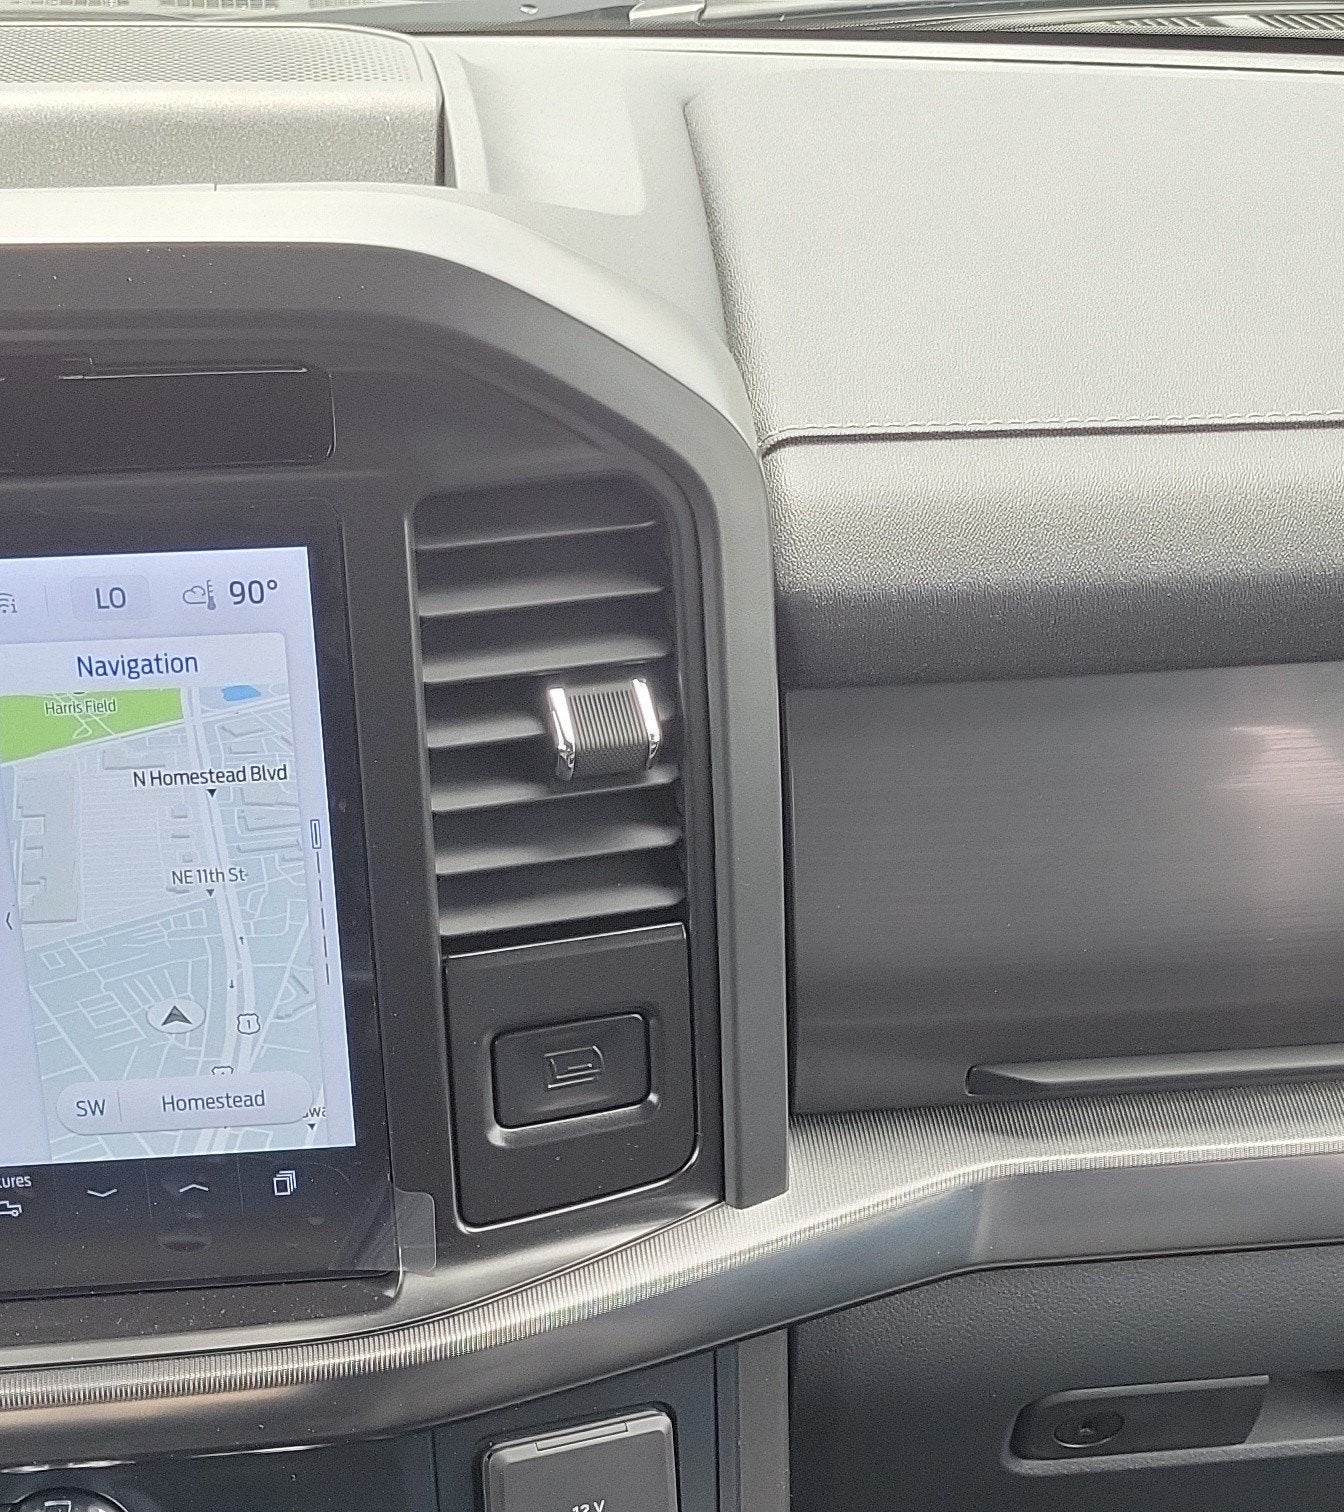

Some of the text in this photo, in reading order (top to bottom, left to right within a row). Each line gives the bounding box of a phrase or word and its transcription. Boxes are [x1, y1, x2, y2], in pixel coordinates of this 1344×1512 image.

[95, 586, 127, 610] LO
[228, 579, 278, 606] 90°
[76, 651, 200, 680] Navigation
[44, 698, 117, 716] Harris Field
[132, 764, 288, 787] N Homestead Blvd
[171, 866, 246, 885] NE 11th St
[76, 1089, 266, 1117] SW Homestead
